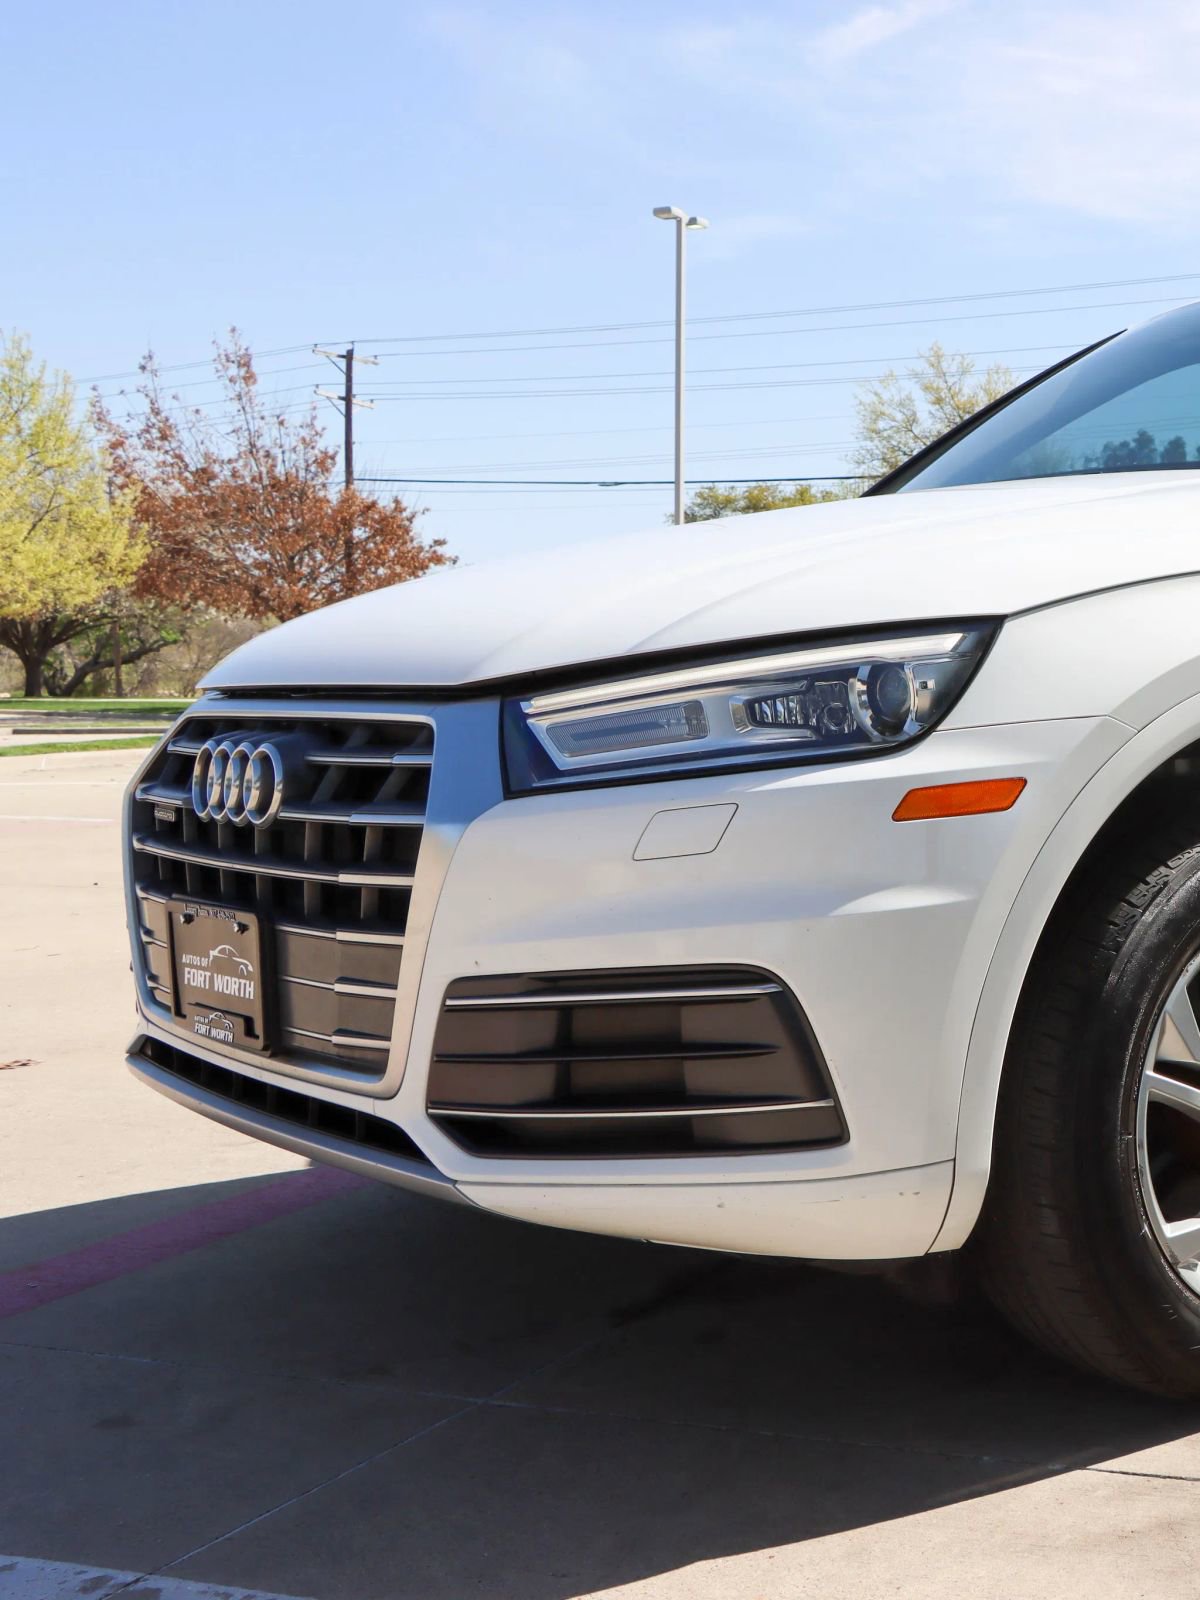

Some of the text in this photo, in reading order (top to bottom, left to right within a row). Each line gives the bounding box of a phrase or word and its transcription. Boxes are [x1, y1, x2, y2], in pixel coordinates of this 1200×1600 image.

[182, 953, 208, 967] AUTOS OF
[184, 967, 254, 999] FORT WORTH
[195, 1022, 233, 1043] FORT WORTH
